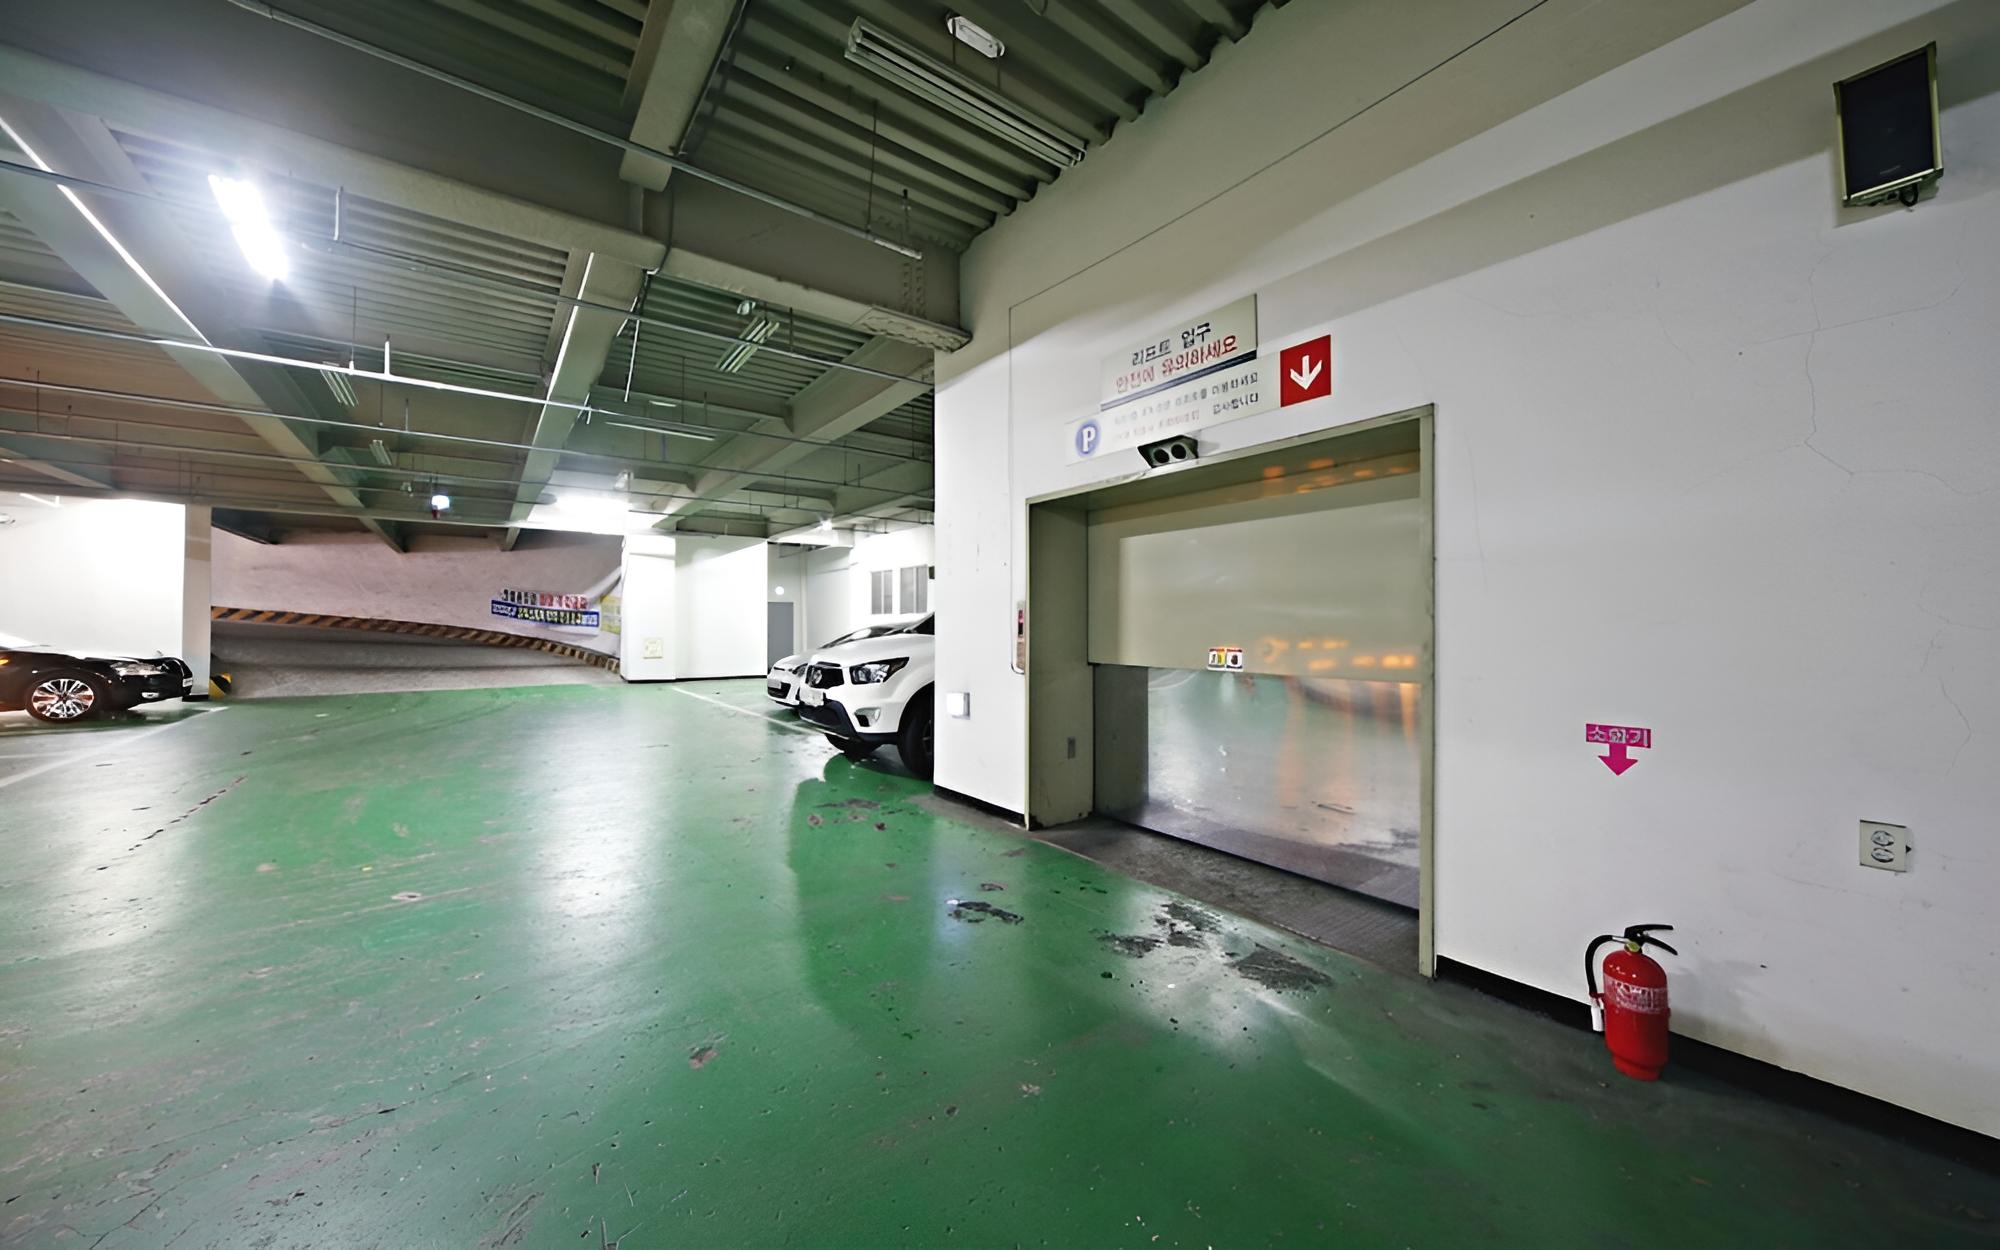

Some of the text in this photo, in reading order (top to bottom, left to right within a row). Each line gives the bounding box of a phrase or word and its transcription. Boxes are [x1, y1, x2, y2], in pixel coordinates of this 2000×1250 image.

[1181, 322, 1211, 349] 입구
[1116, 334, 1238, 394] 안전에 유의하세요
[1082, 425, 1097, 453] P
[1588, 726, 1649, 747] 소화기
